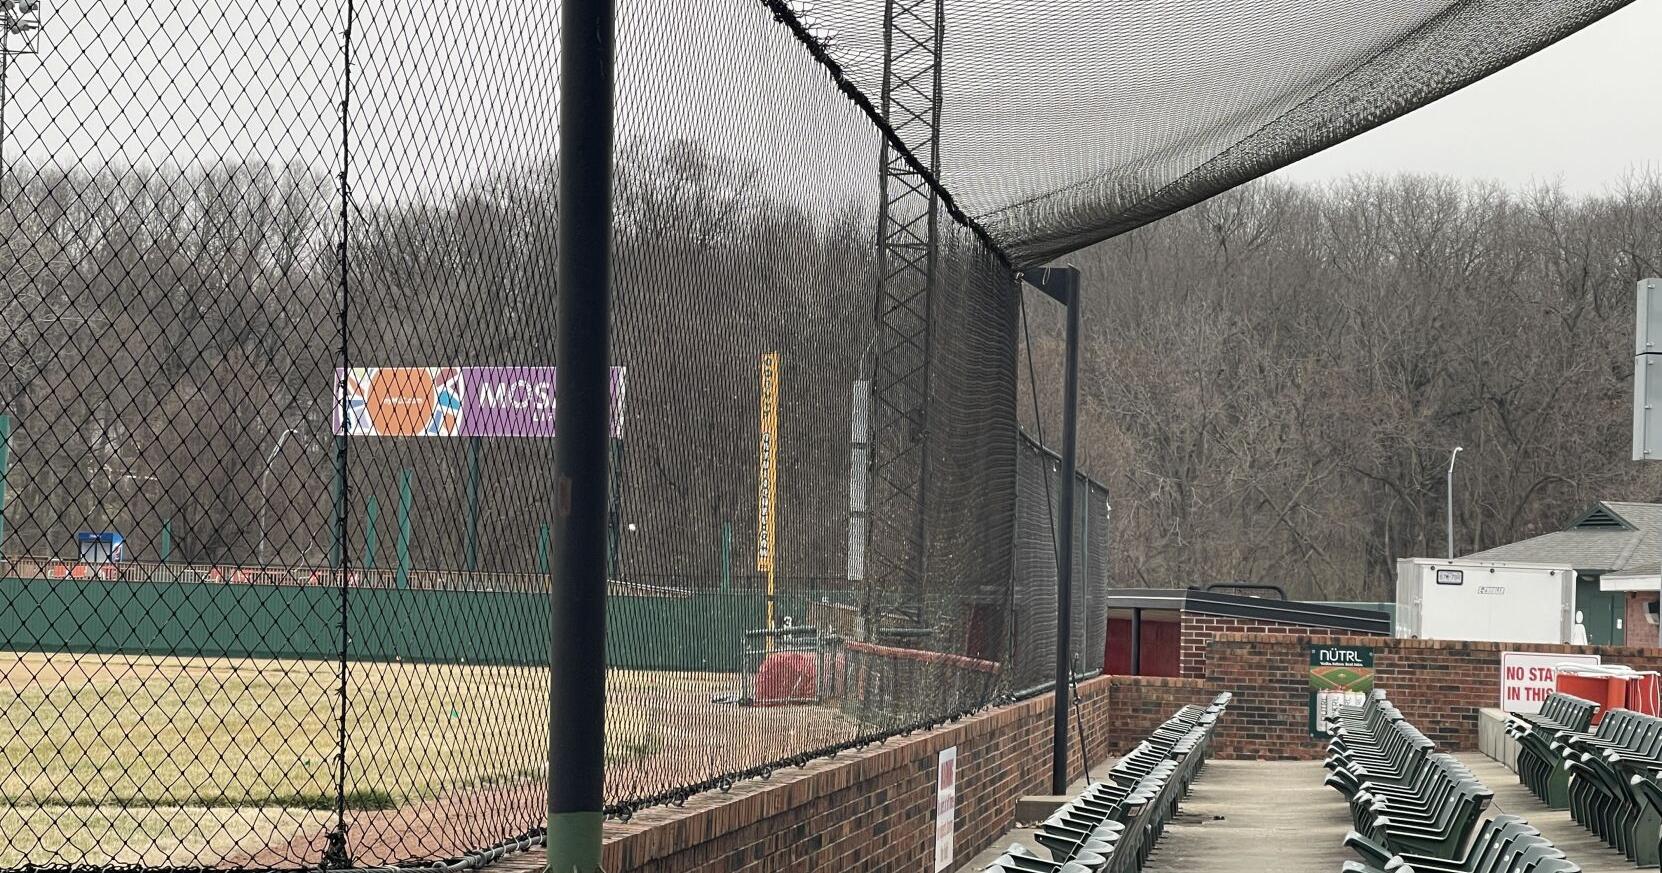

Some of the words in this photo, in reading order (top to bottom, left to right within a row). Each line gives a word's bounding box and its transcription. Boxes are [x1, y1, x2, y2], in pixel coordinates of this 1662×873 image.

[479, 380, 556, 409] MOS
[1320, 648, 1363, 663] NÜTRL
[1506, 666, 1524, 681] NO
[1529, 667, 1553, 682] STA
[1507, 686, 1521, 701] IN
